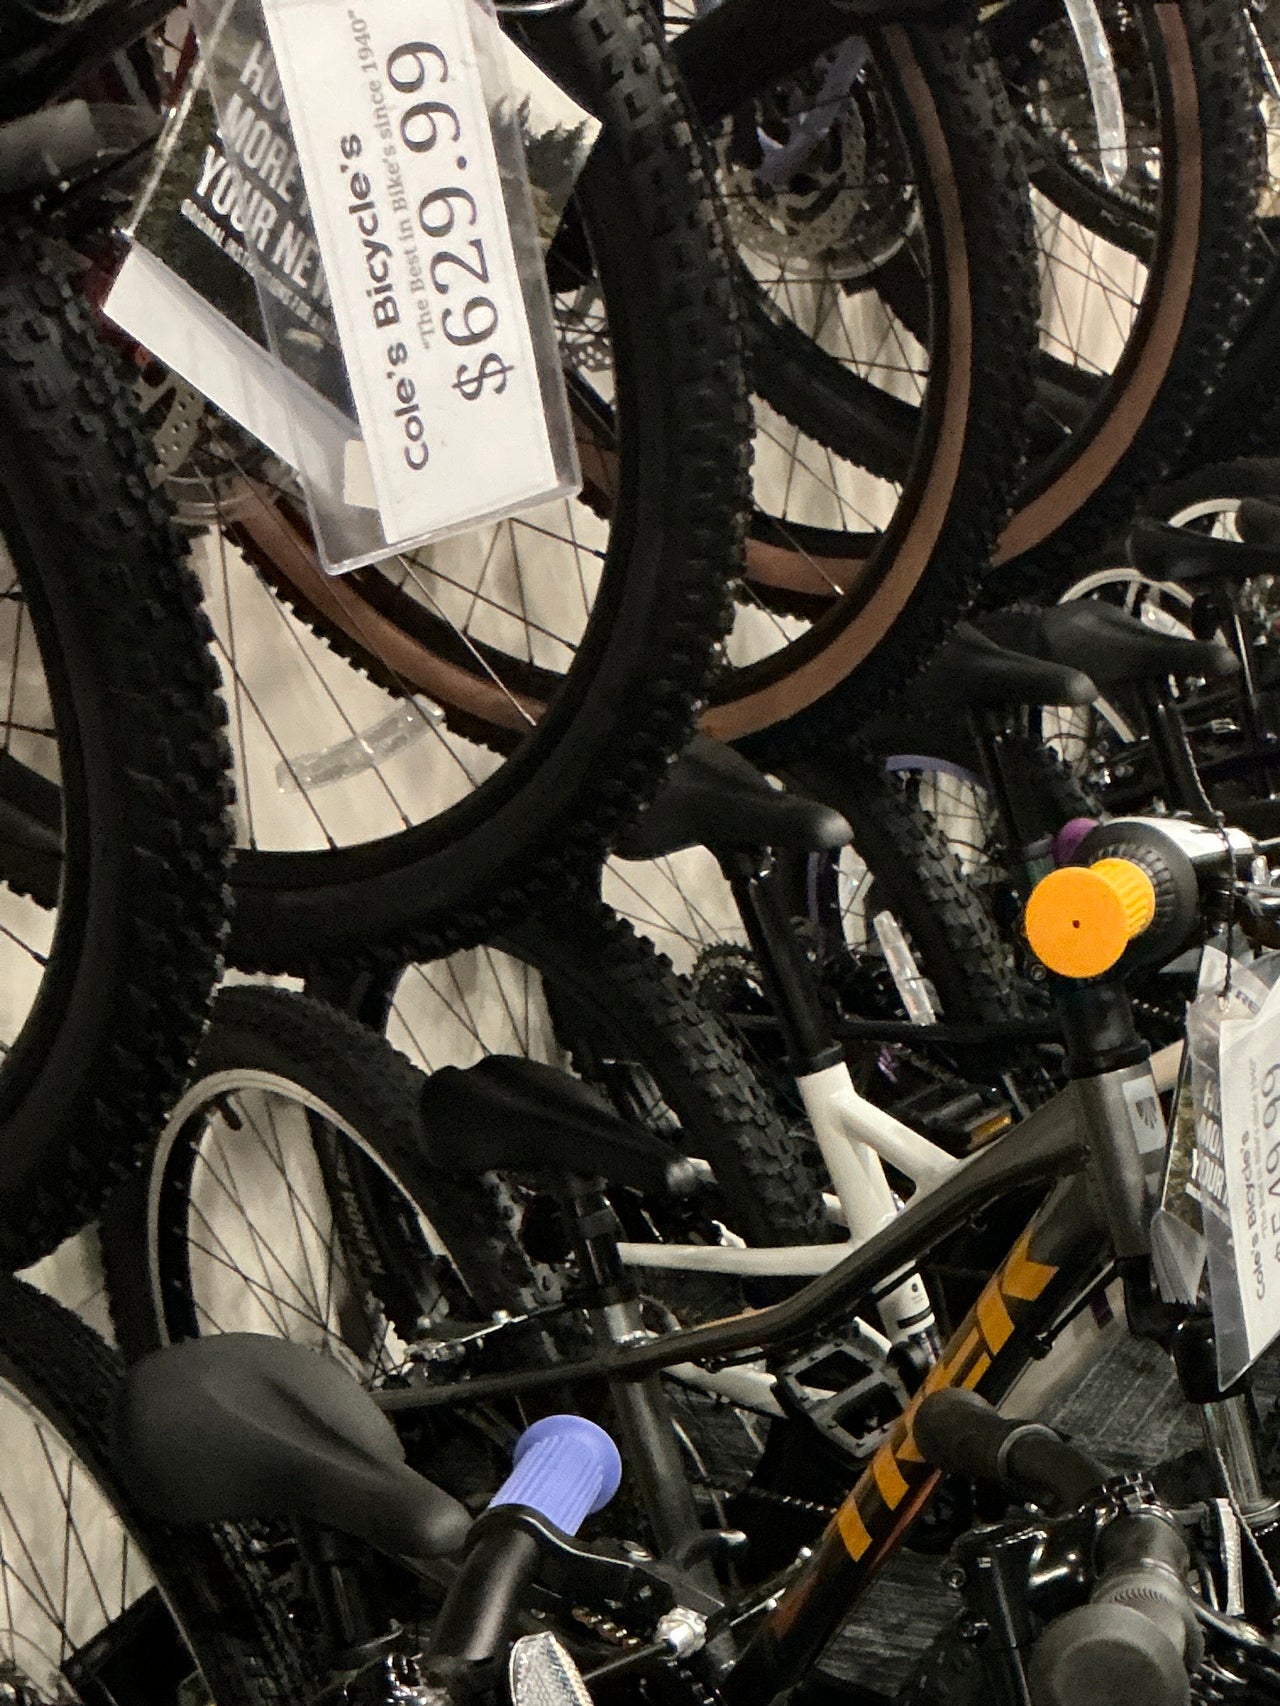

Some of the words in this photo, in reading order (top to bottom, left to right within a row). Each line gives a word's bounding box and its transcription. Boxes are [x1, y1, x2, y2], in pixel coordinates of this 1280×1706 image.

[370, 79, 397, 141] since
[197, 145, 279, 252] YOUR
[383, 145, 410, 222] Bike's
[387, 41, 514, 401] $629.99
[340, 134, 401, 329] Bicycle's
[399, 225, 416, 246] in
[401, 247, 427, 299] Best
[387, 341, 429, 470] Cole's
[1240, 1129, 1257, 1230] Bicycle's
[1250, 1232, 1266, 1301] Cole's
